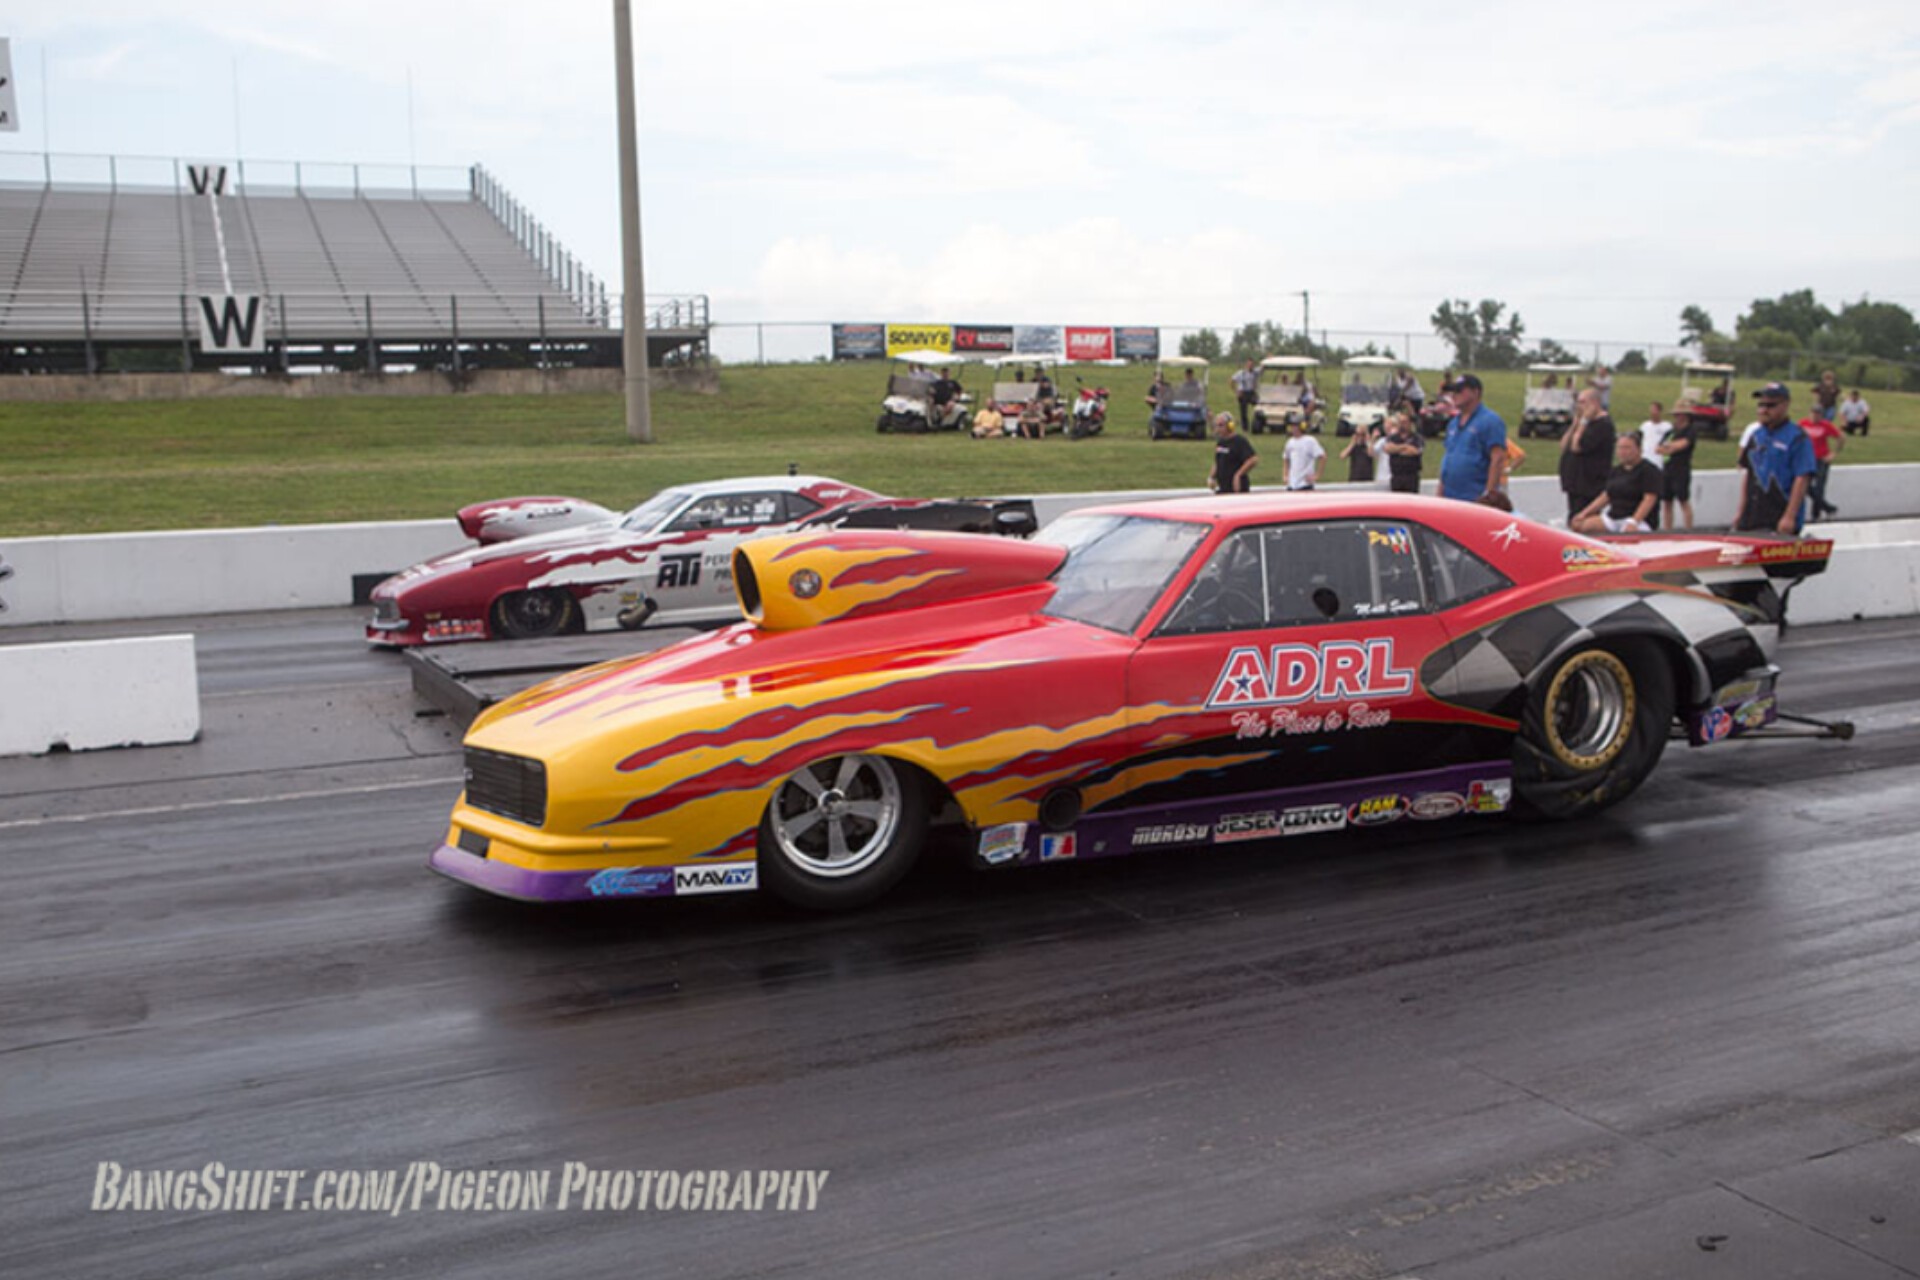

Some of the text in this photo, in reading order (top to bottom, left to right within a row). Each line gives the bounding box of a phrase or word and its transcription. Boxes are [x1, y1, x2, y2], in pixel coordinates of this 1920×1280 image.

[201, 296, 259, 347] W
[889, 330, 949, 345] SONNY'S
[657, 553, 702, 588] ATI
[1206, 638, 1415, 709] ADRL
[1231, 702, 1391, 740] The Place to Race
[676, 868, 754, 888] MAVTV
